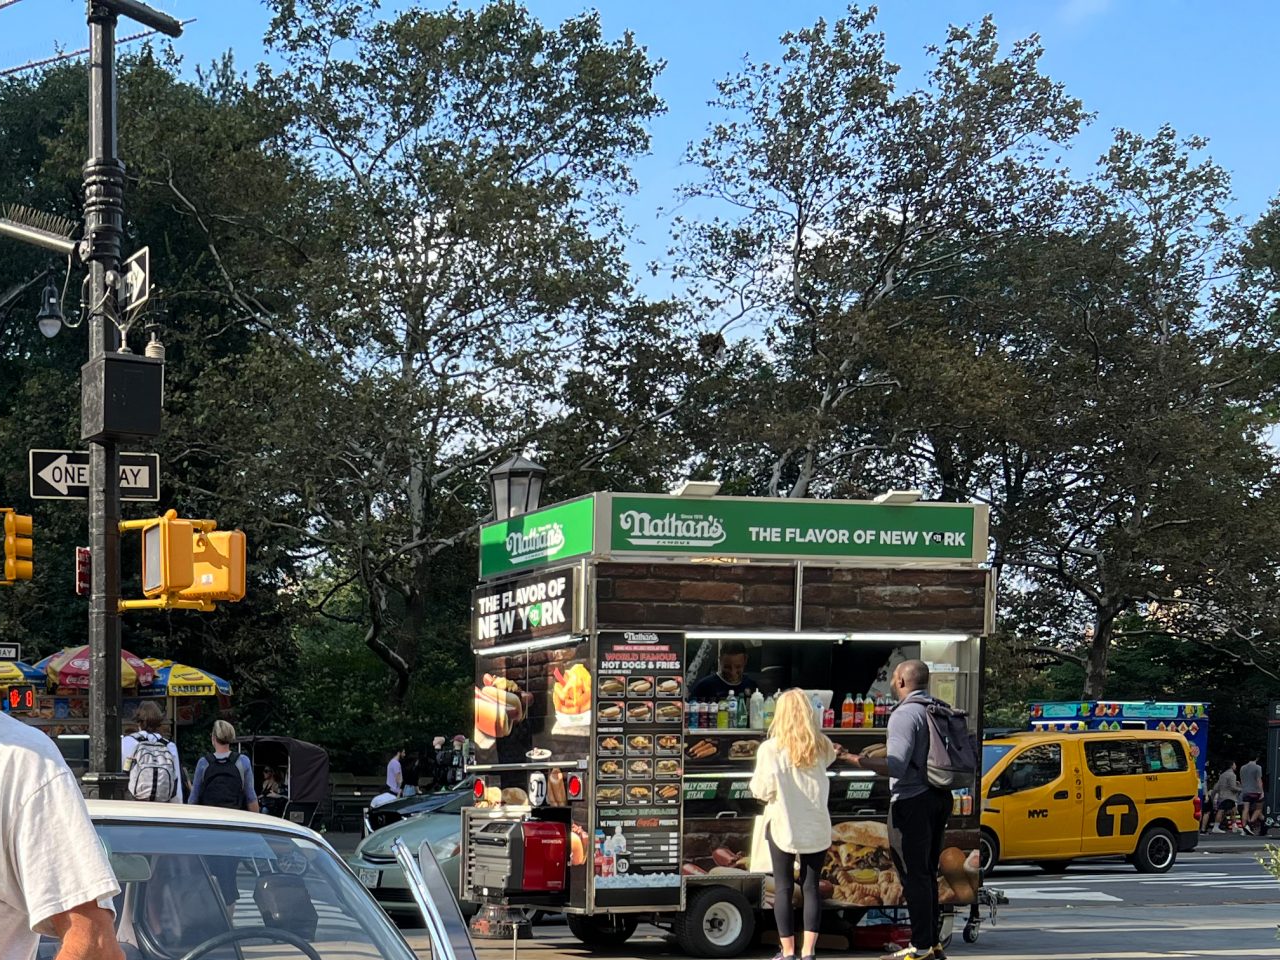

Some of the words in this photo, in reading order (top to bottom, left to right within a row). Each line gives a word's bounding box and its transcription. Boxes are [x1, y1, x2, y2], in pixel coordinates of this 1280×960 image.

[52, 466, 87, 484] ONE
[119, 468, 142, 485] AY
[620, 510, 723, 538] Nathan's
[749, 527, 781, 542] THE
[785, 528, 849, 544] FLAVOR
[853, 530, 876, 544] OF
[879, 530, 918, 545] NEW
[922, 532, 966, 547] YRK
[478, 594, 500, 614] THE
[502, 582, 546, 609] FLAVOR
[547, 577, 566, 598] OF
[478, 610, 515, 640] NEW
[518, 598, 565, 631] YRK
[601, 661, 620, 669] HOT
[621, 661, 646, 669] DOGS
[647, 661, 654, 669] &
[655, 661, 680, 669] FRIES
[605, 653, 639, 661] WORLD
[640, 653, 677, 661] FAMOUS
[171, 685, 213, 693] SABRETT
[1028, 809, 1048, 818] NYC
